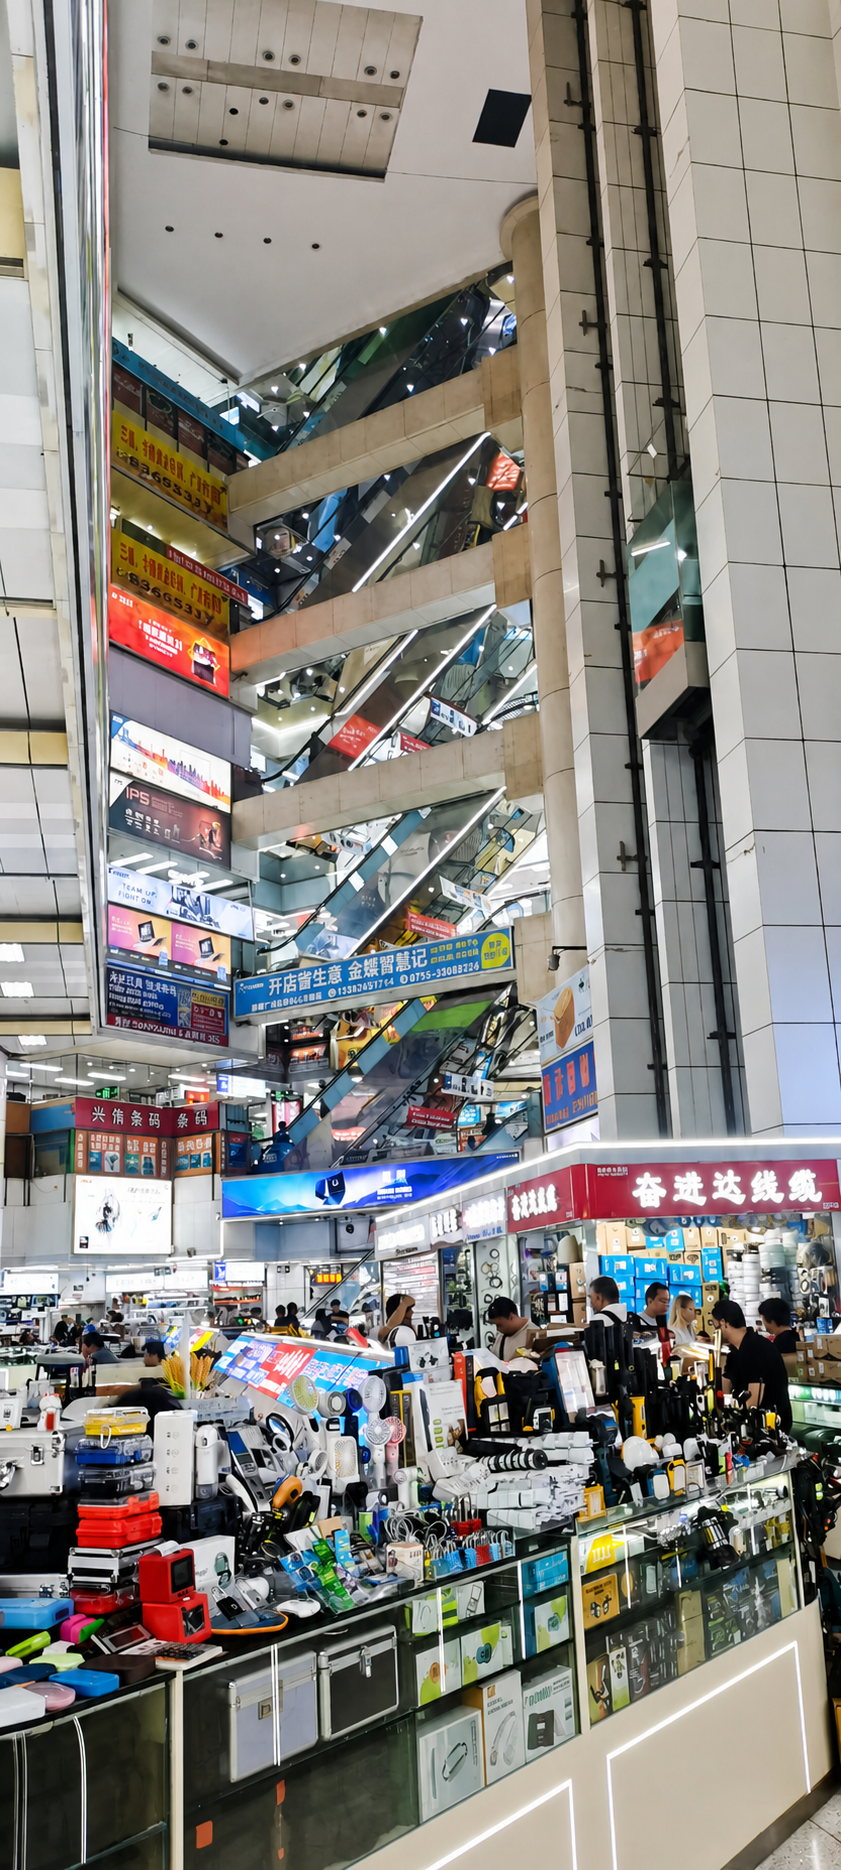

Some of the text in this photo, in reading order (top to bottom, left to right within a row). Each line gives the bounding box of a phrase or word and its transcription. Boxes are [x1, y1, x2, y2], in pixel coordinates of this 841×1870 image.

[631, 1169, 823, 1209] 奋进达线缆
